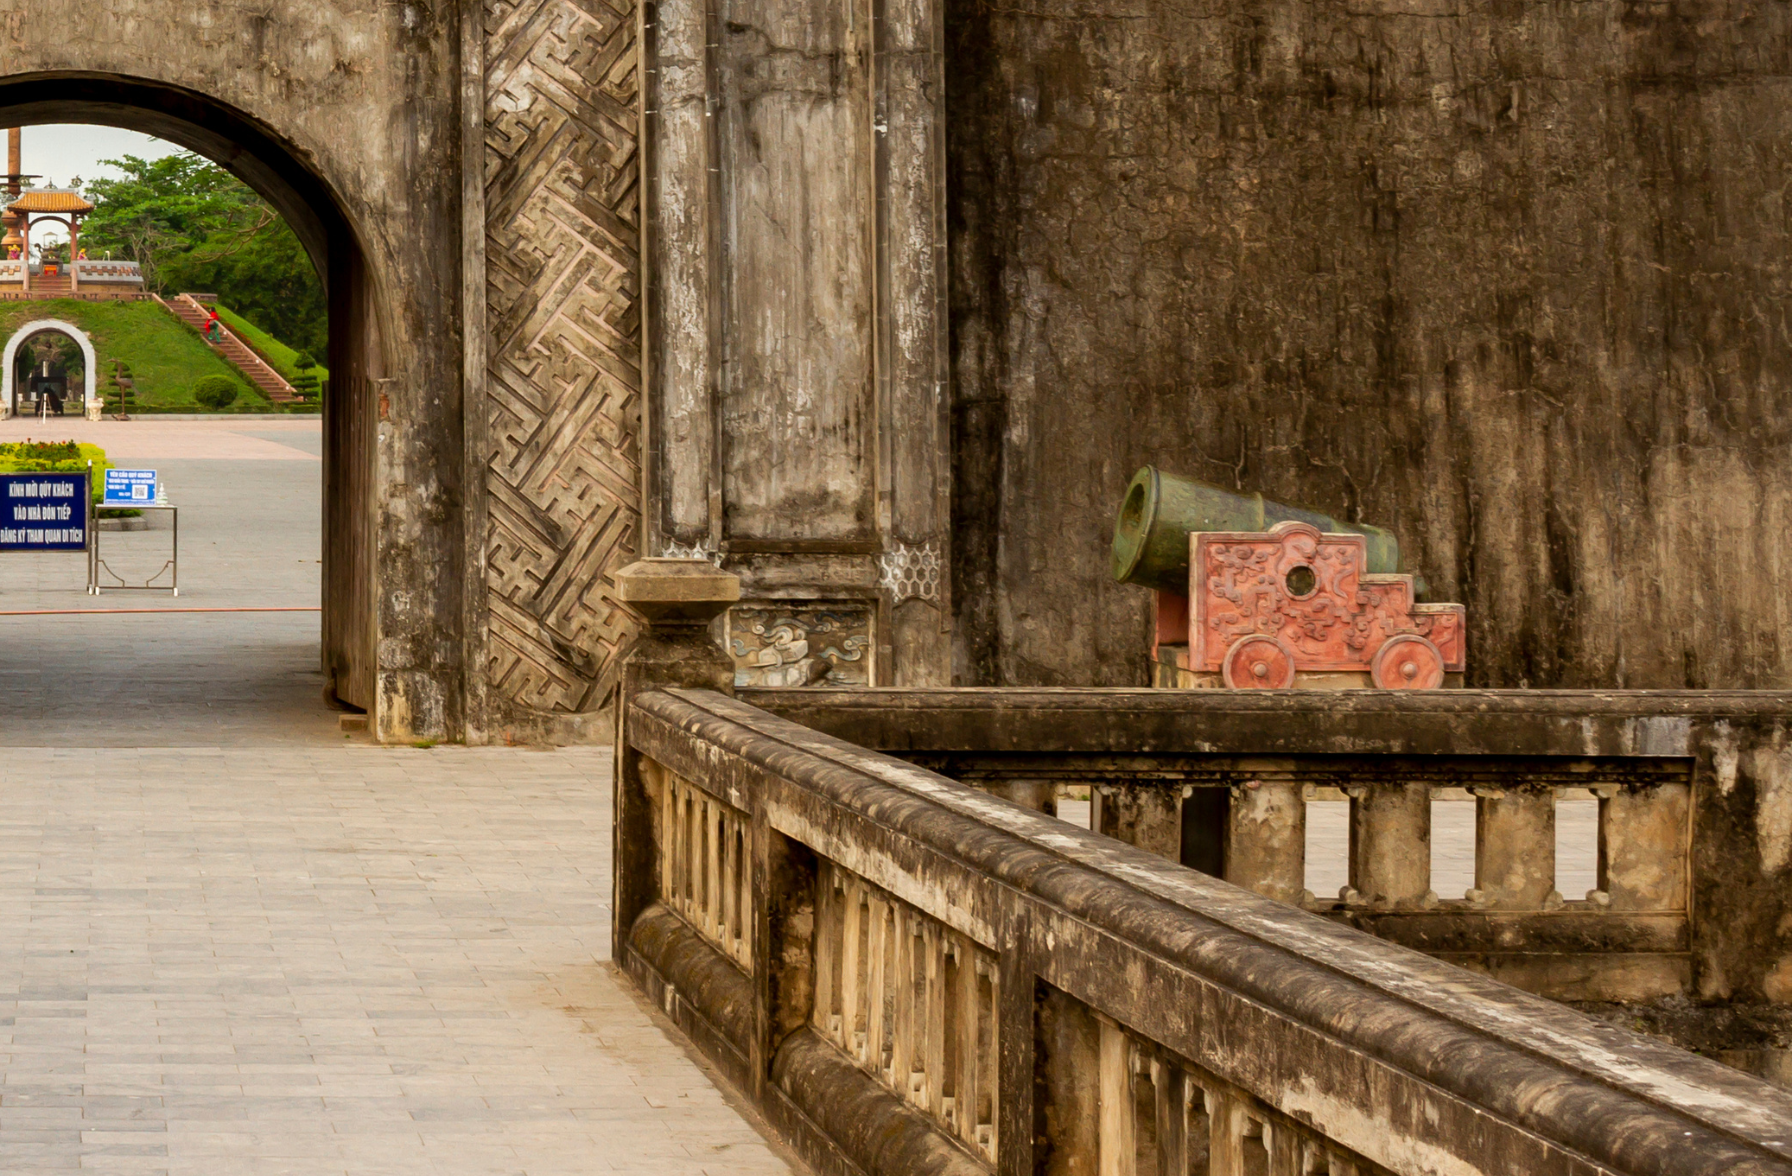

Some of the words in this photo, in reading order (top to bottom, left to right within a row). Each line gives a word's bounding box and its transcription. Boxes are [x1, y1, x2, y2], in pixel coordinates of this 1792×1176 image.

[9, 480, 24, 497] KÍNH
[25, 480, 38, 497] MỜI
[52, 480, 74, 497] KHÁCH
[13, 503, 26, 520] VÀO
[28, 503, 42, 520] NHÀ
[42, 503, 56, 520] ĐÓN
[56, 502, 72, 520] TIẾP
[0, 526, 17, 543] ĐĂNG
[18, 526, 26, 543] KÝ
[27, 529, 44, 543] THAM
[44, 529, 62, 544] QUAN
[62, 529, 69, 542] DI
[70, 526, 83, 542] TÍCH
